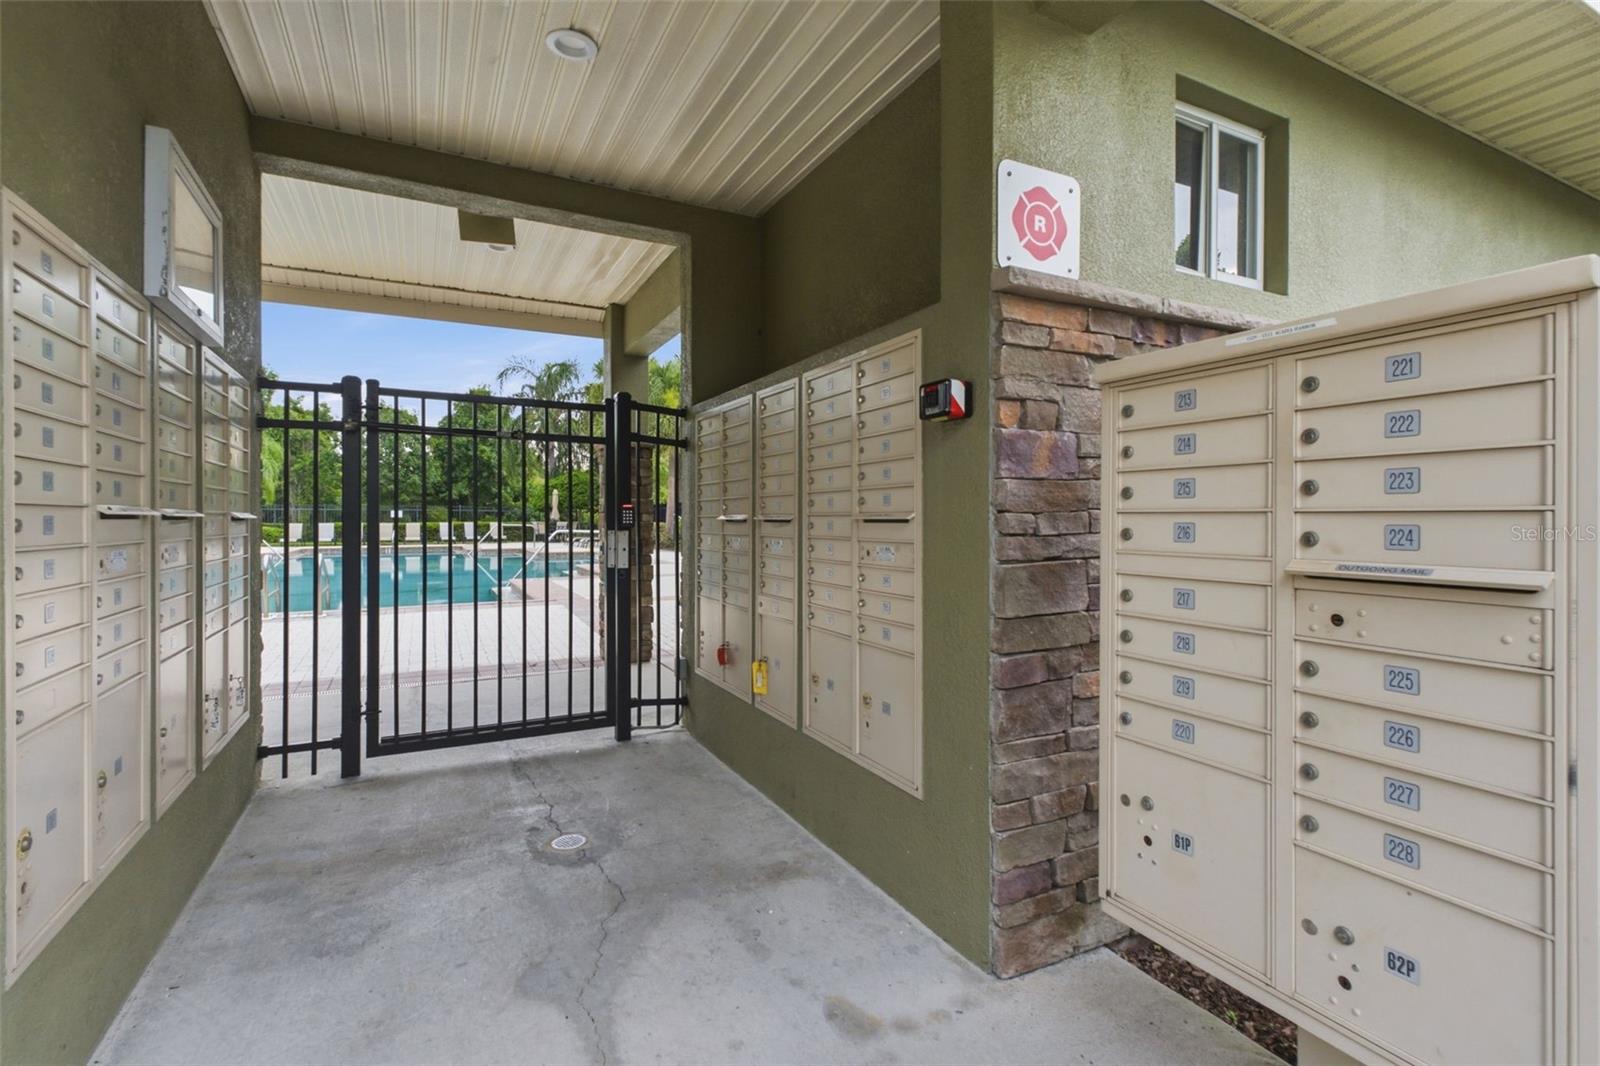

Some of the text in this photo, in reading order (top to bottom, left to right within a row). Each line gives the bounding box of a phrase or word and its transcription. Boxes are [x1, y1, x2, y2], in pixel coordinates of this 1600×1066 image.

[1034, 214, 1047, 233] R
[1392, 357, 1413, 377] 221
[1177, 392, 1192, 409] 213
[1390, 414, 1414, 434] 222
[1177, 436, 1192, 452] 214
[1177, 481, 1191, 496] 215
[1389, 471, 1414, 490] 223
[1177, 525, 1191, 540] 216
[1389, 528, 1414, 547] 224
[1338, 564, 1426, 576] OUTGOING MAIL
[1177, 591, 1191, 607] 217
[1176, 635, 1190, 651] 218
[1176, 679, 1190, 695] 219
[1389, 669, 1414, 690] 225
[1175, 723, 1191, 740] 220
[1389, 726, 1414, 748] 226
[1389, 782, 1414, 805] 227
[1174, 833, 1191, 852] 61P
[1389, 839, 1414, 864] 228
[1387, 951, 1416, 978] 62P
